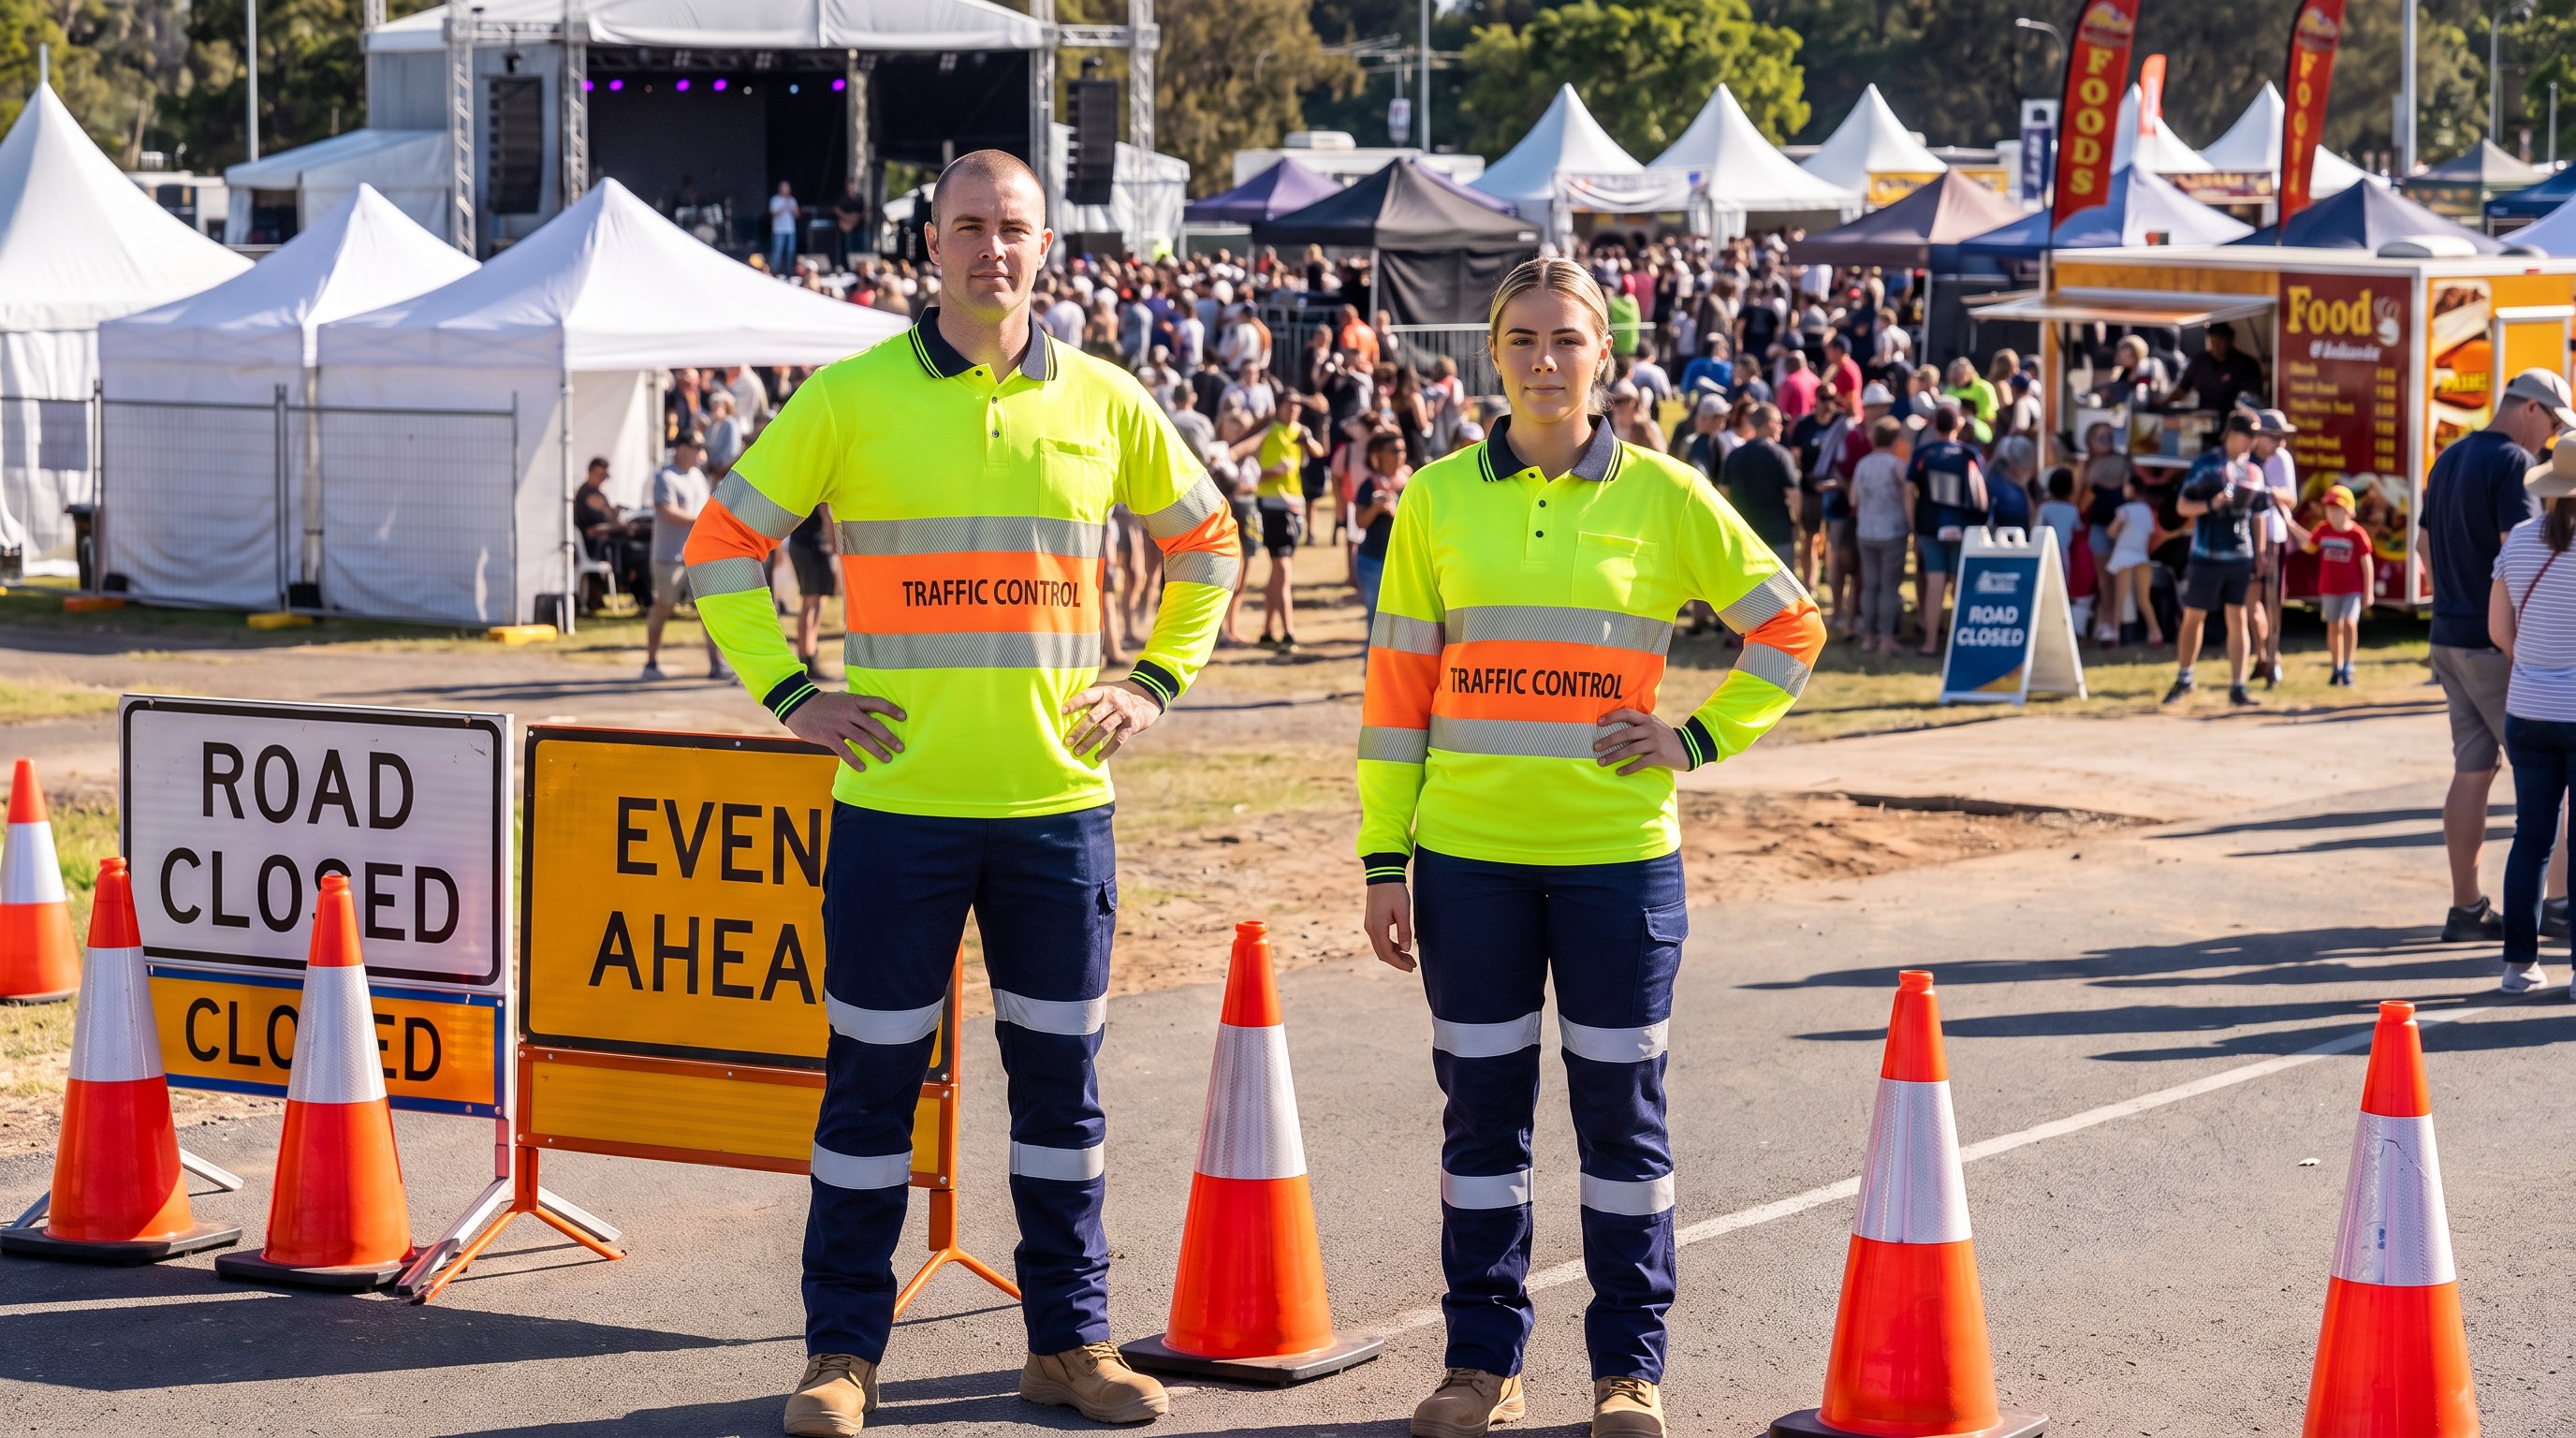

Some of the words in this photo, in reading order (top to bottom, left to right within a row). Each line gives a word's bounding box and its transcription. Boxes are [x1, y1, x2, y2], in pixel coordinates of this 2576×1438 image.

[2069, 48, 2114, 196] FOODS
[2286, 285, 2373, 337] Food
[902, 579, 988, 608] TRAFFIC
[993, 579, 1080, 608] CONTROL
[1968, 605, 2019, 624] ROAD
[1955, 627, 2025, 647] CLOSED
[1450, 667, 1527, 695] TRAFFIC
[1531, 669, 1622, 700] CONTROL
[202, 741, 414, 829] ROAD
[617, 796, 822, 888] EVEN
[588, 910, 825, 1005] AHEA
